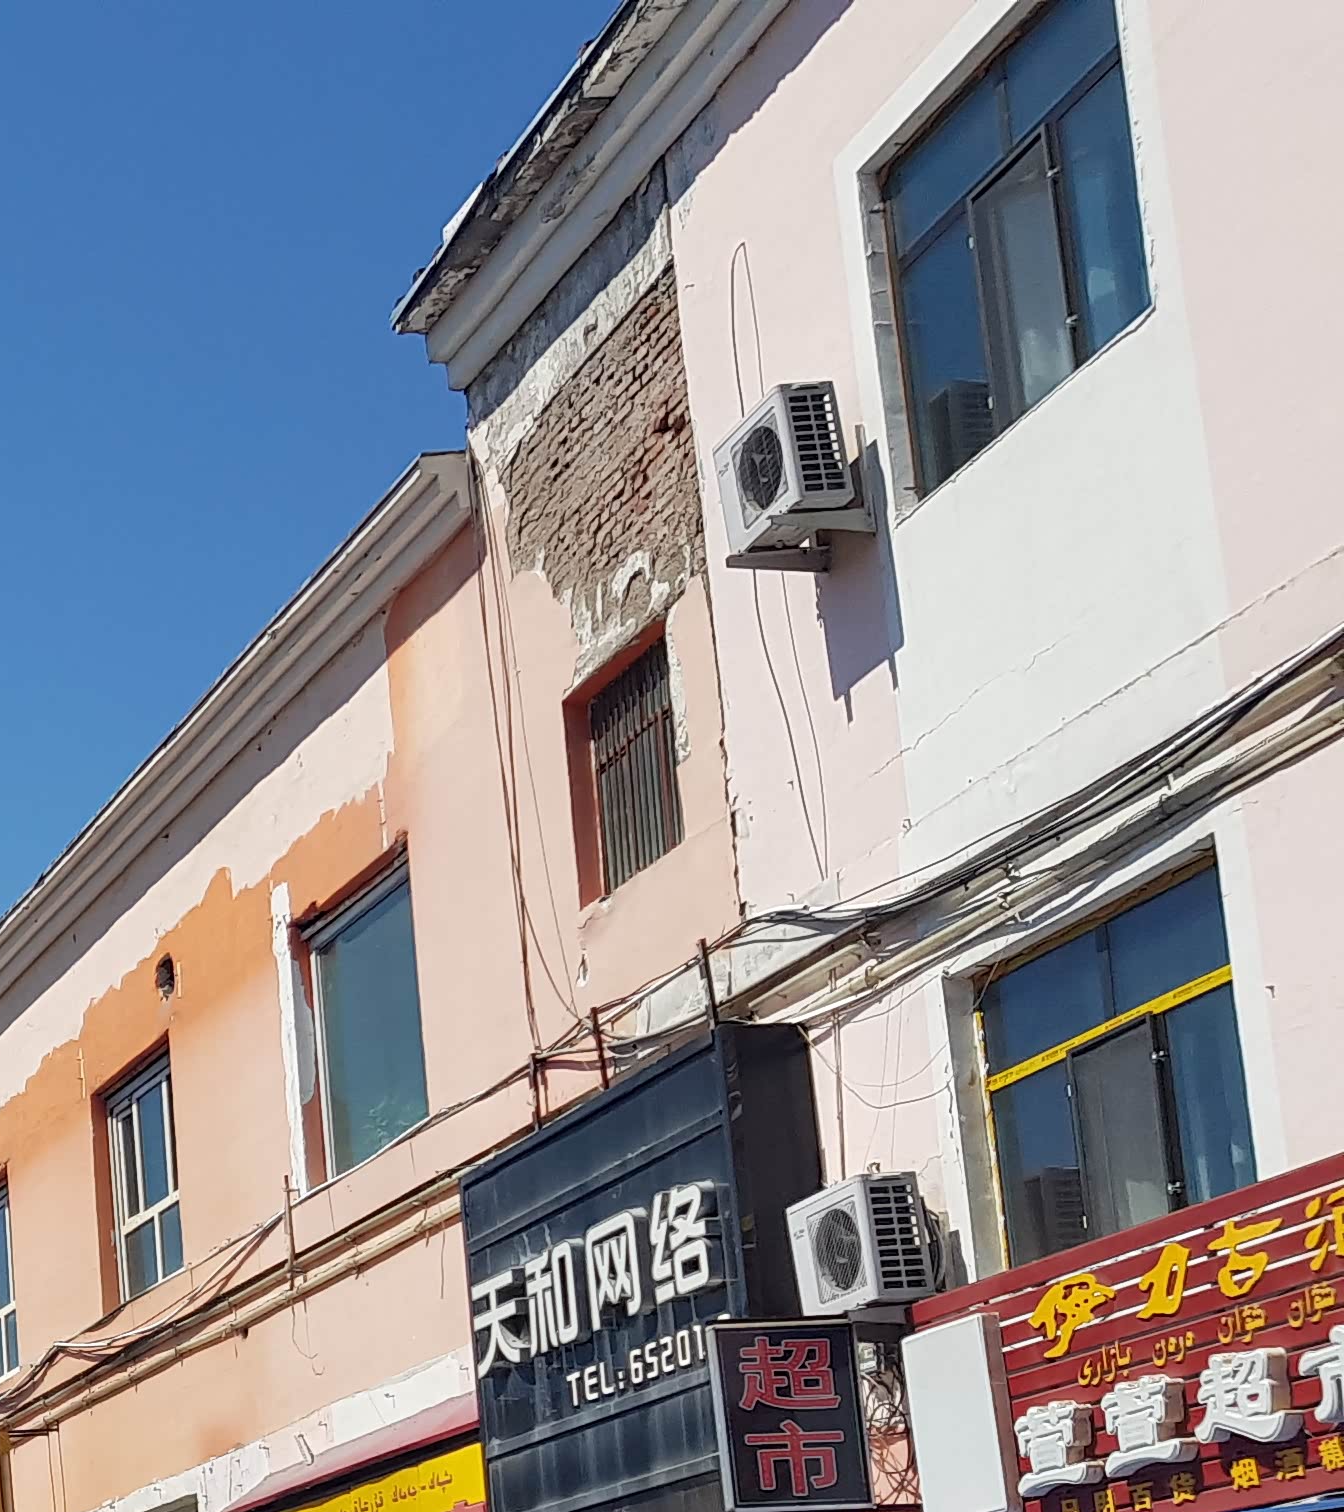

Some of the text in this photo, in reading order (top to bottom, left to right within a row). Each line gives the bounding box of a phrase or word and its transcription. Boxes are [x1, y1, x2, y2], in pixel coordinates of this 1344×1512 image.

[471, 1181, 716, 1381] 天和网络
[739, 1334, 846, 1498] 超市
